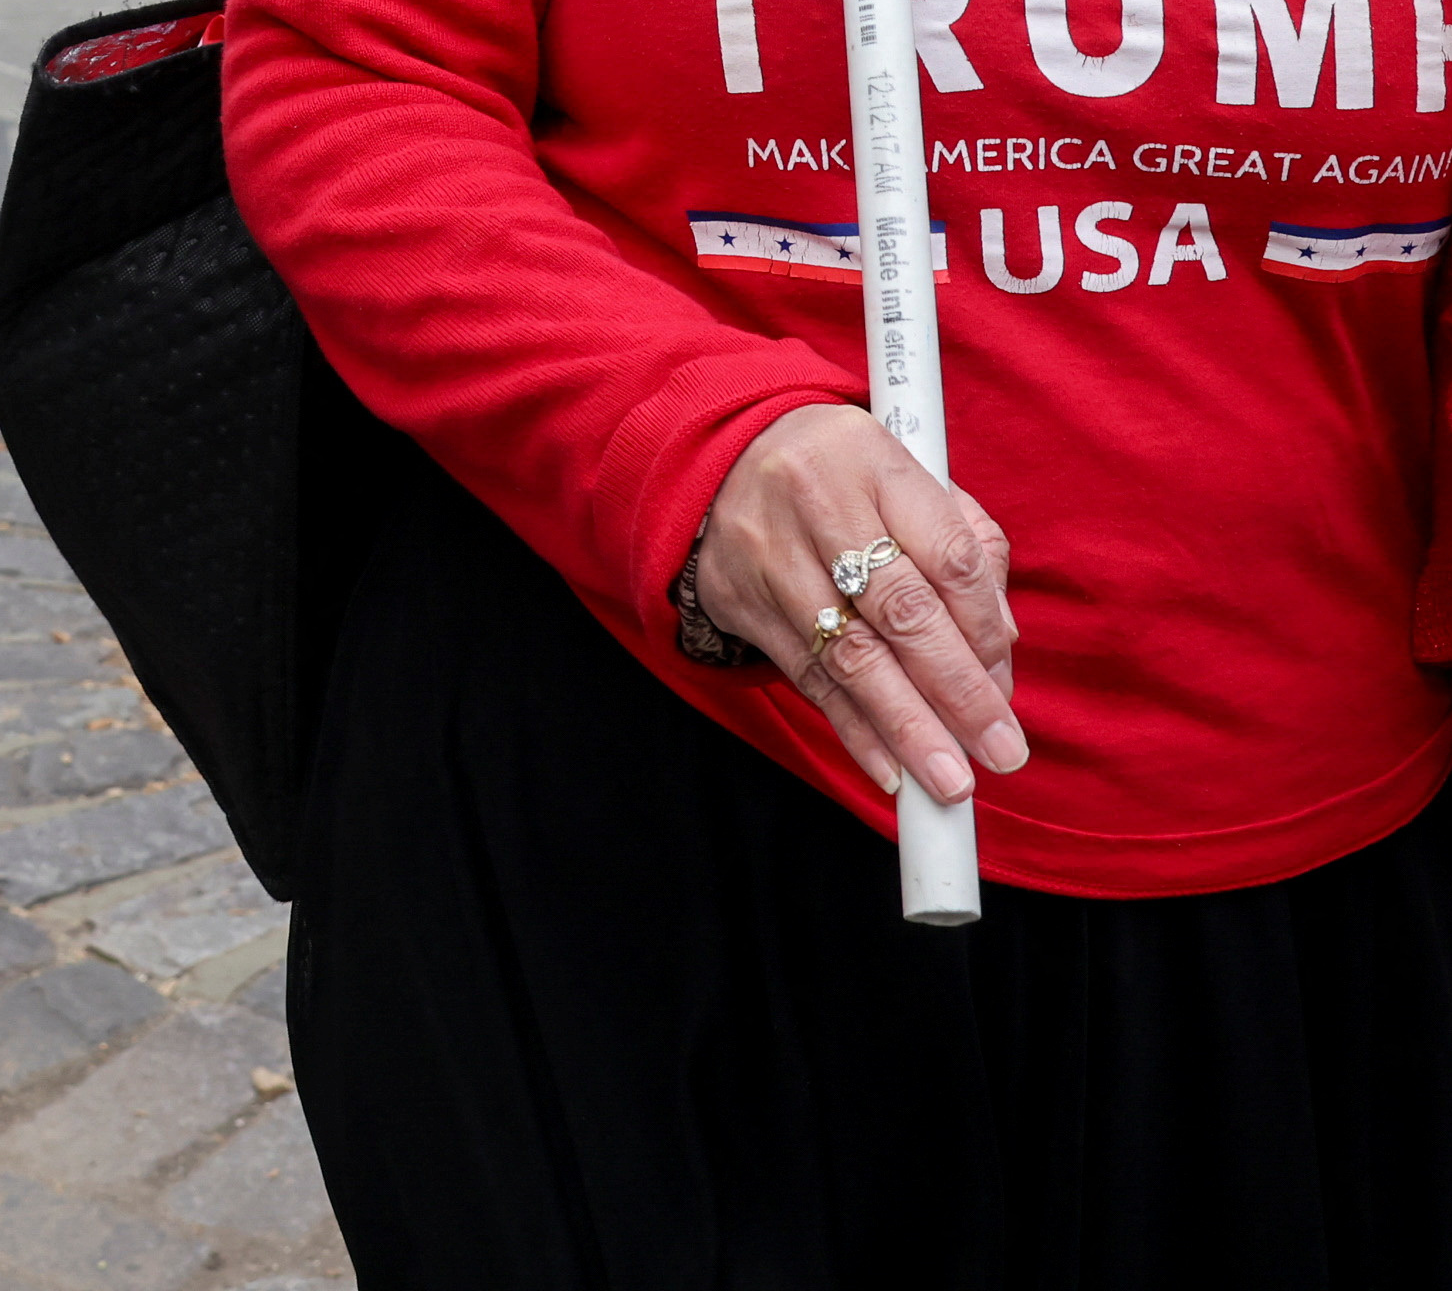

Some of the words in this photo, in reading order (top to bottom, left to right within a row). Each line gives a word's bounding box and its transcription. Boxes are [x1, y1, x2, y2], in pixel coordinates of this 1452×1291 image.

[746, 137, 851, 171] MAK
[923, 138, 1117, 174] MERICA
[1131, 141, 1302, 183] GREAT
[872, 161, 904, 195] AM
[876, 215, 911, 281] Made
[980, 200, 1229, 295] USA
